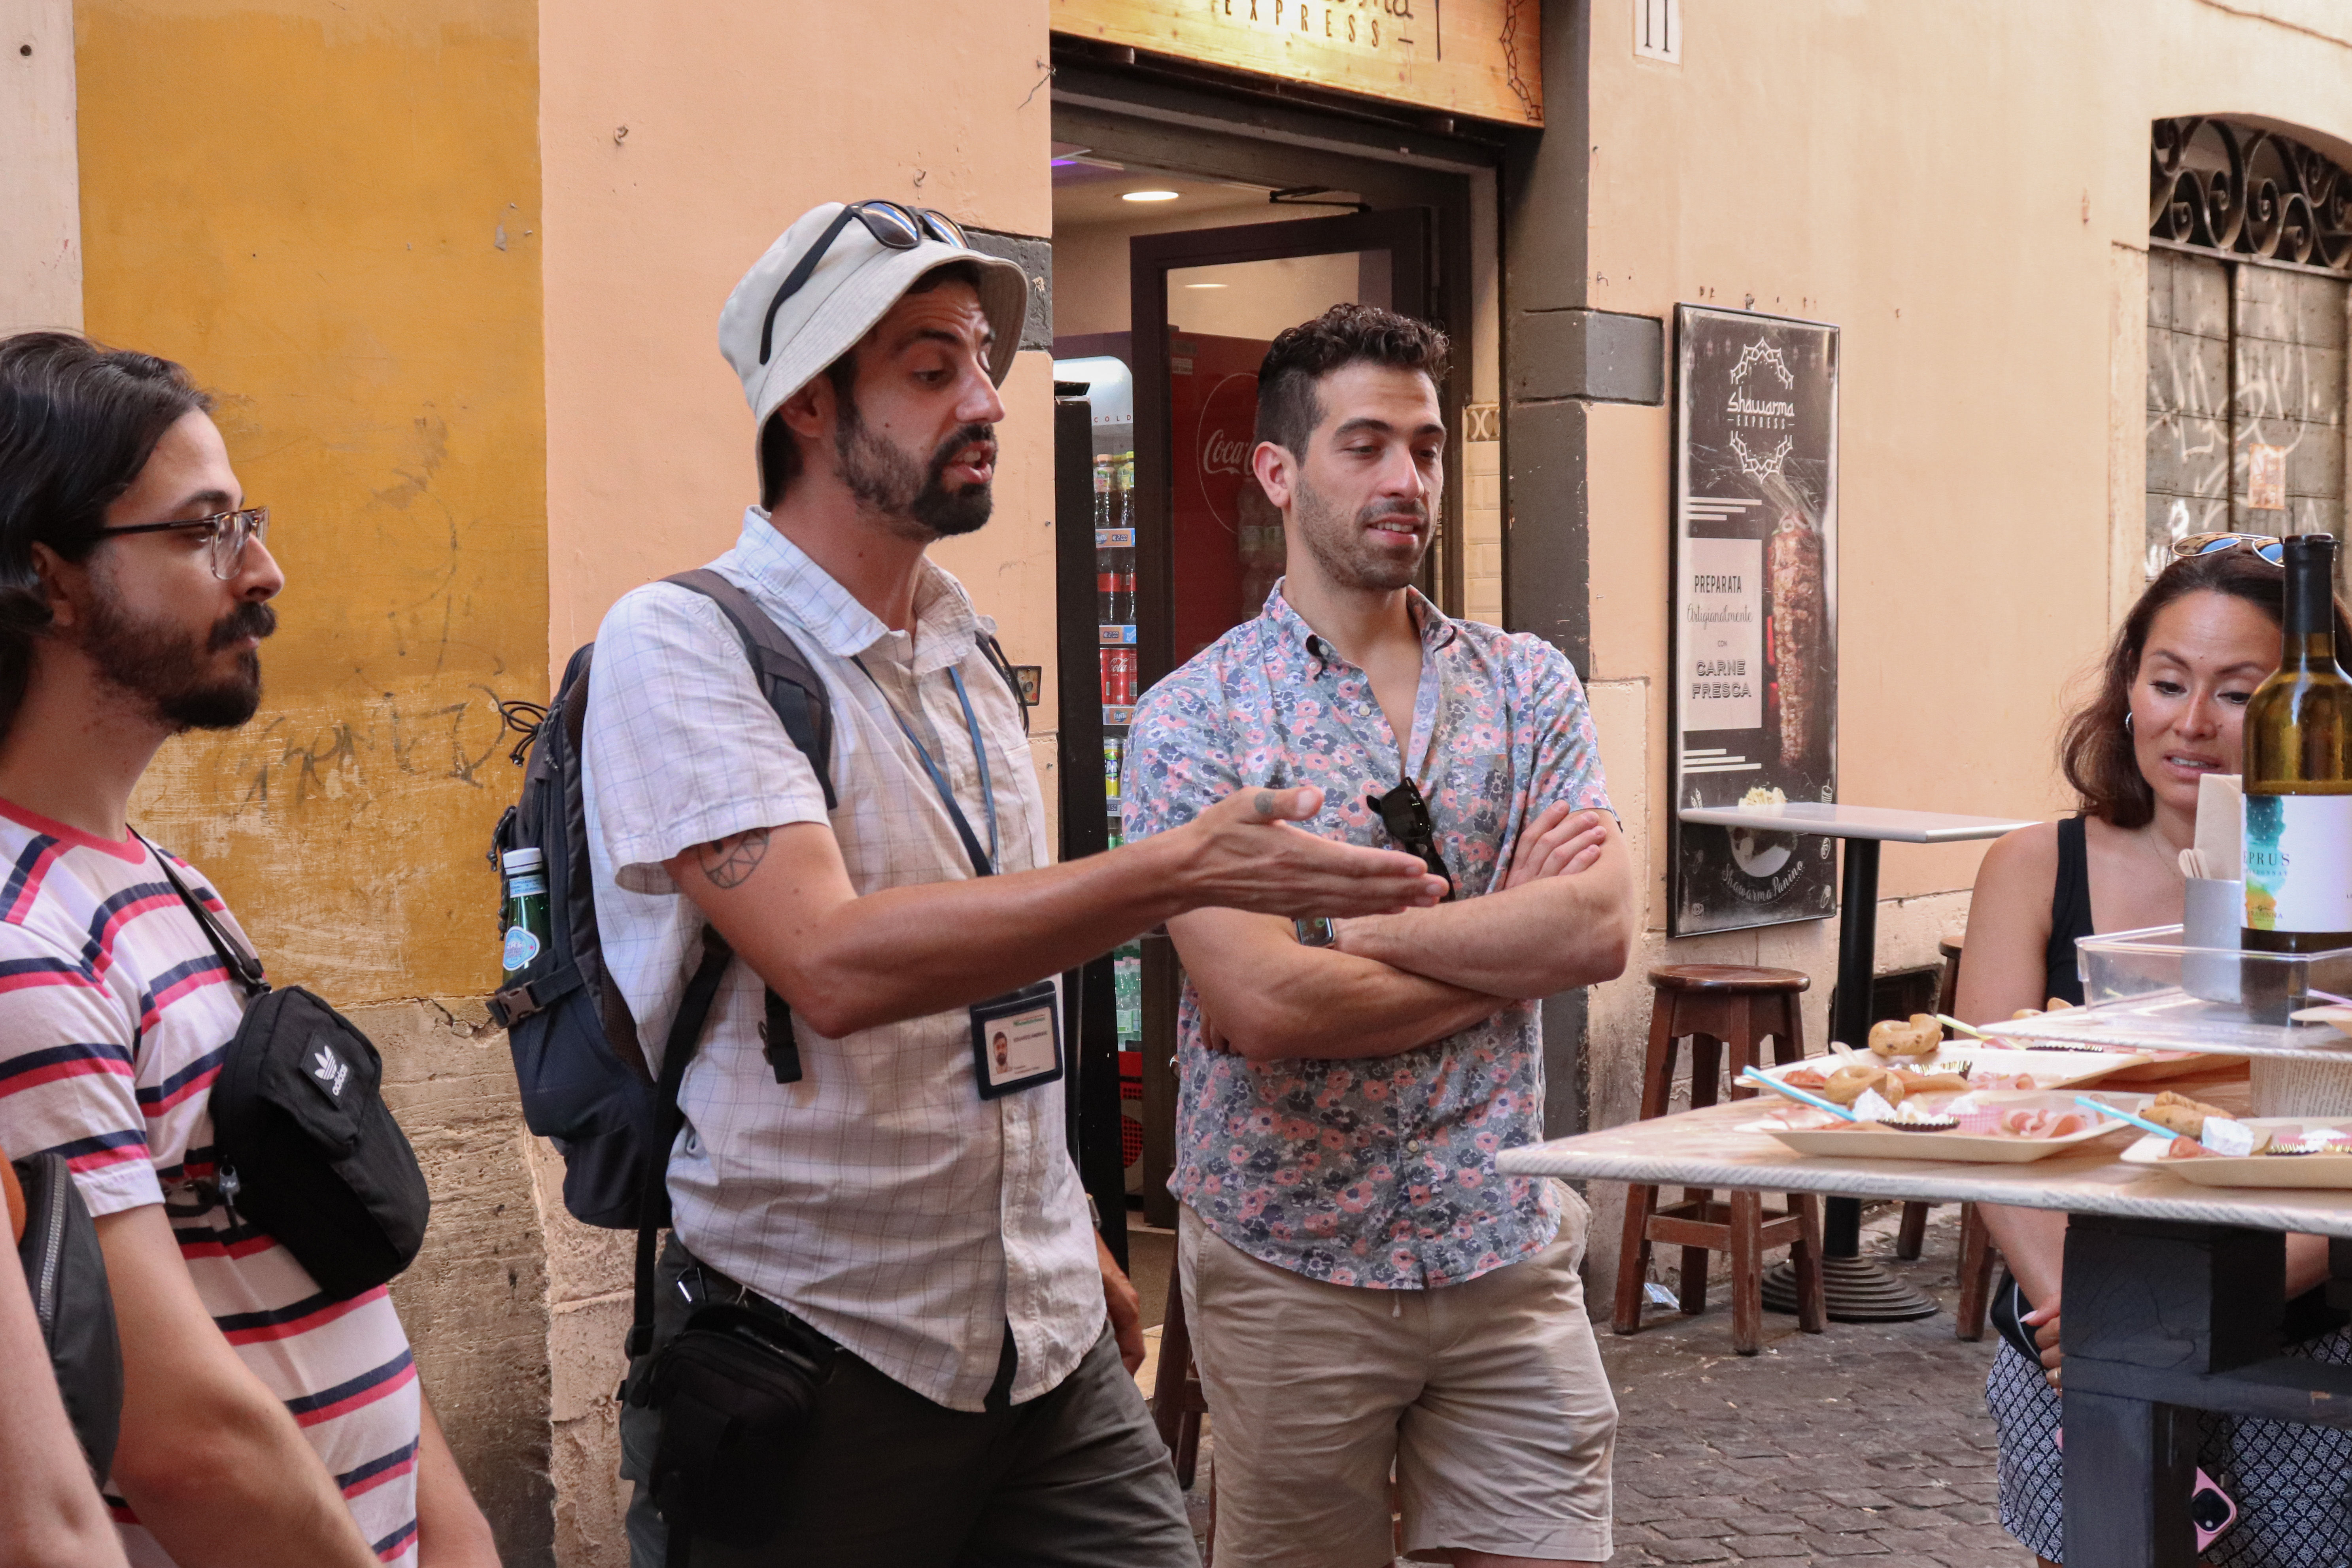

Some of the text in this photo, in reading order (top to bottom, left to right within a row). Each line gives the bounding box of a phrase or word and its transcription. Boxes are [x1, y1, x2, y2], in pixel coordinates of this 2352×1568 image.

[1727, 386, 1795, 417] Shawarma
[1737, 415, 1785, 430] EXPRESS
[1695, 575, 1742, 593] PREPARATA
[1687, 603, 1753, 630] Artigianalmente
[1696, 659, 1746, 676] CARNE
[1692, 681, 1752, 699] FRESCA
[1721, 860, 1803, 901] Shawarma Panino
[332, 1064, 348, 1096] adidas
